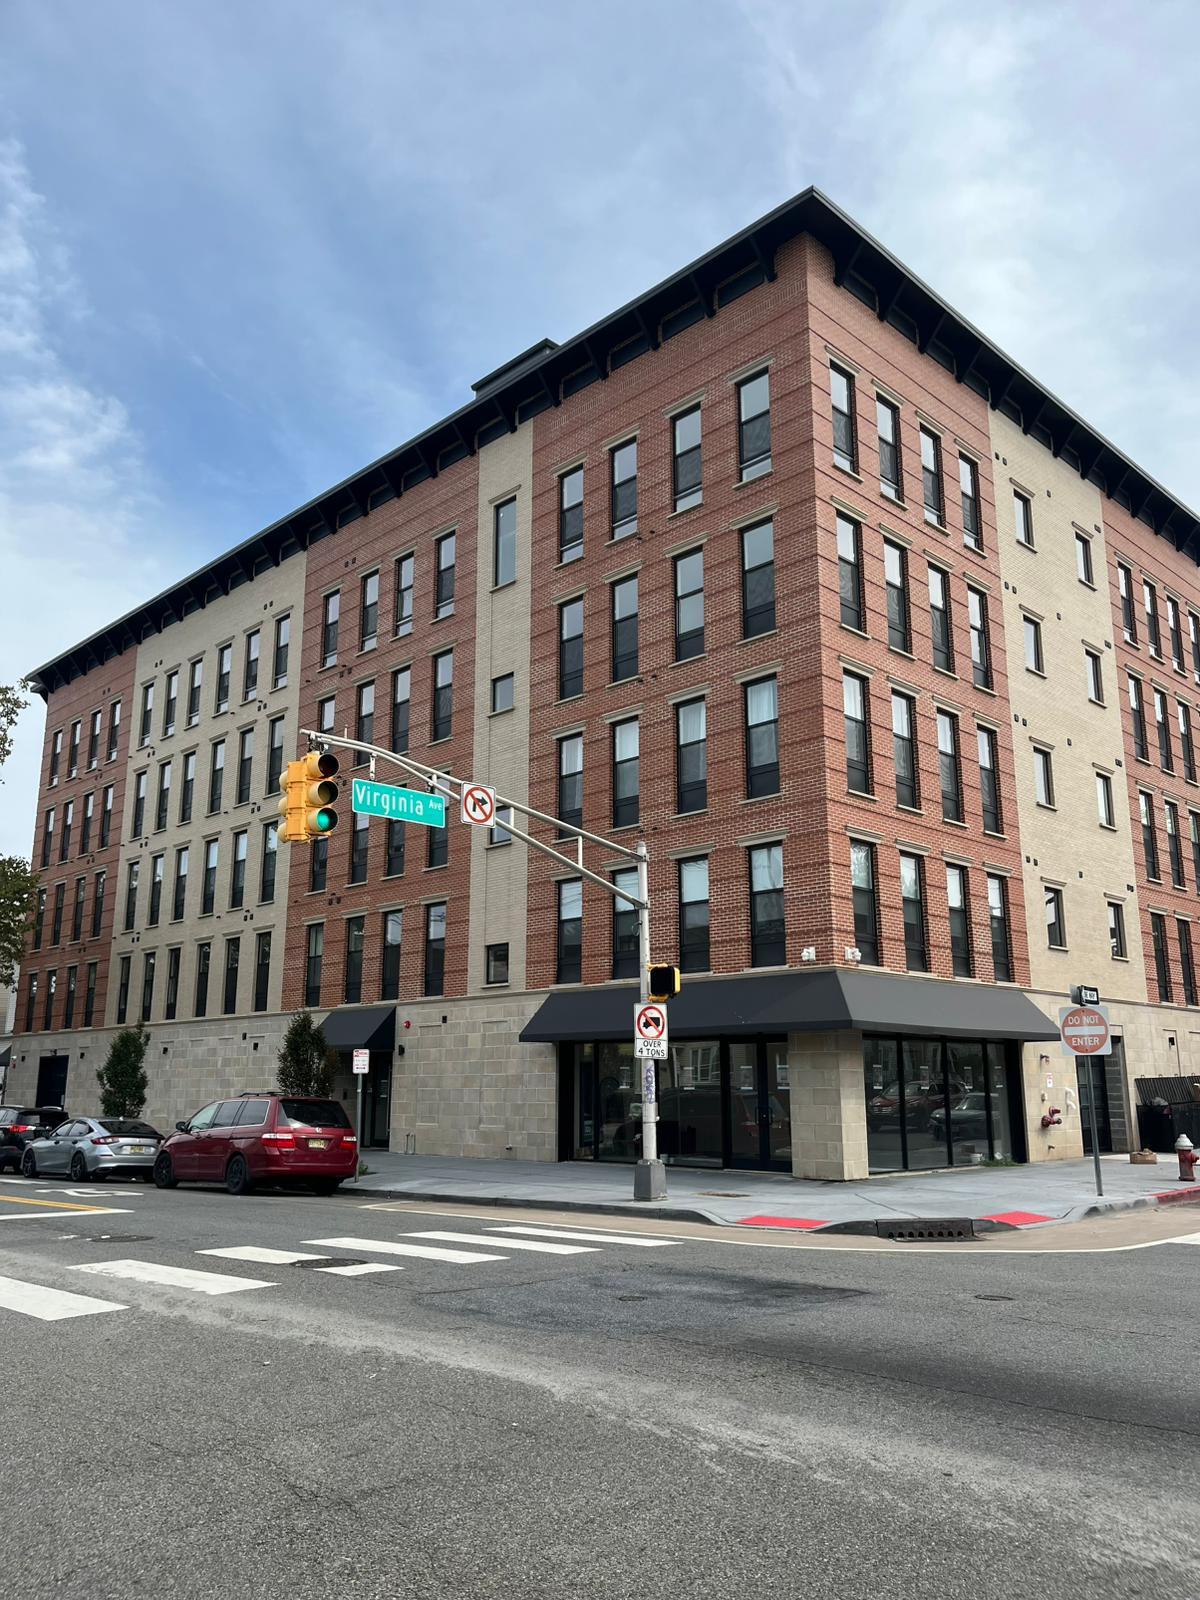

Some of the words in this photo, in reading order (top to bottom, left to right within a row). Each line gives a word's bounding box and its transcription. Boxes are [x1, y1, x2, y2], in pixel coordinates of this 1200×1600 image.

[355, 783, 424, 816] Virginia
[428, 799, 443, 811] Ave
[1067, 1016, 1080, 1025] DO
[1081, 1015, 1100, 1024] NOT
[643, 1040, 662, 1048] OVER
[1071, 1036, 1100, 1046] ENTER
[638, 1047, 644, 1055] 4
[646, 1048, 665, 1057] TONS
